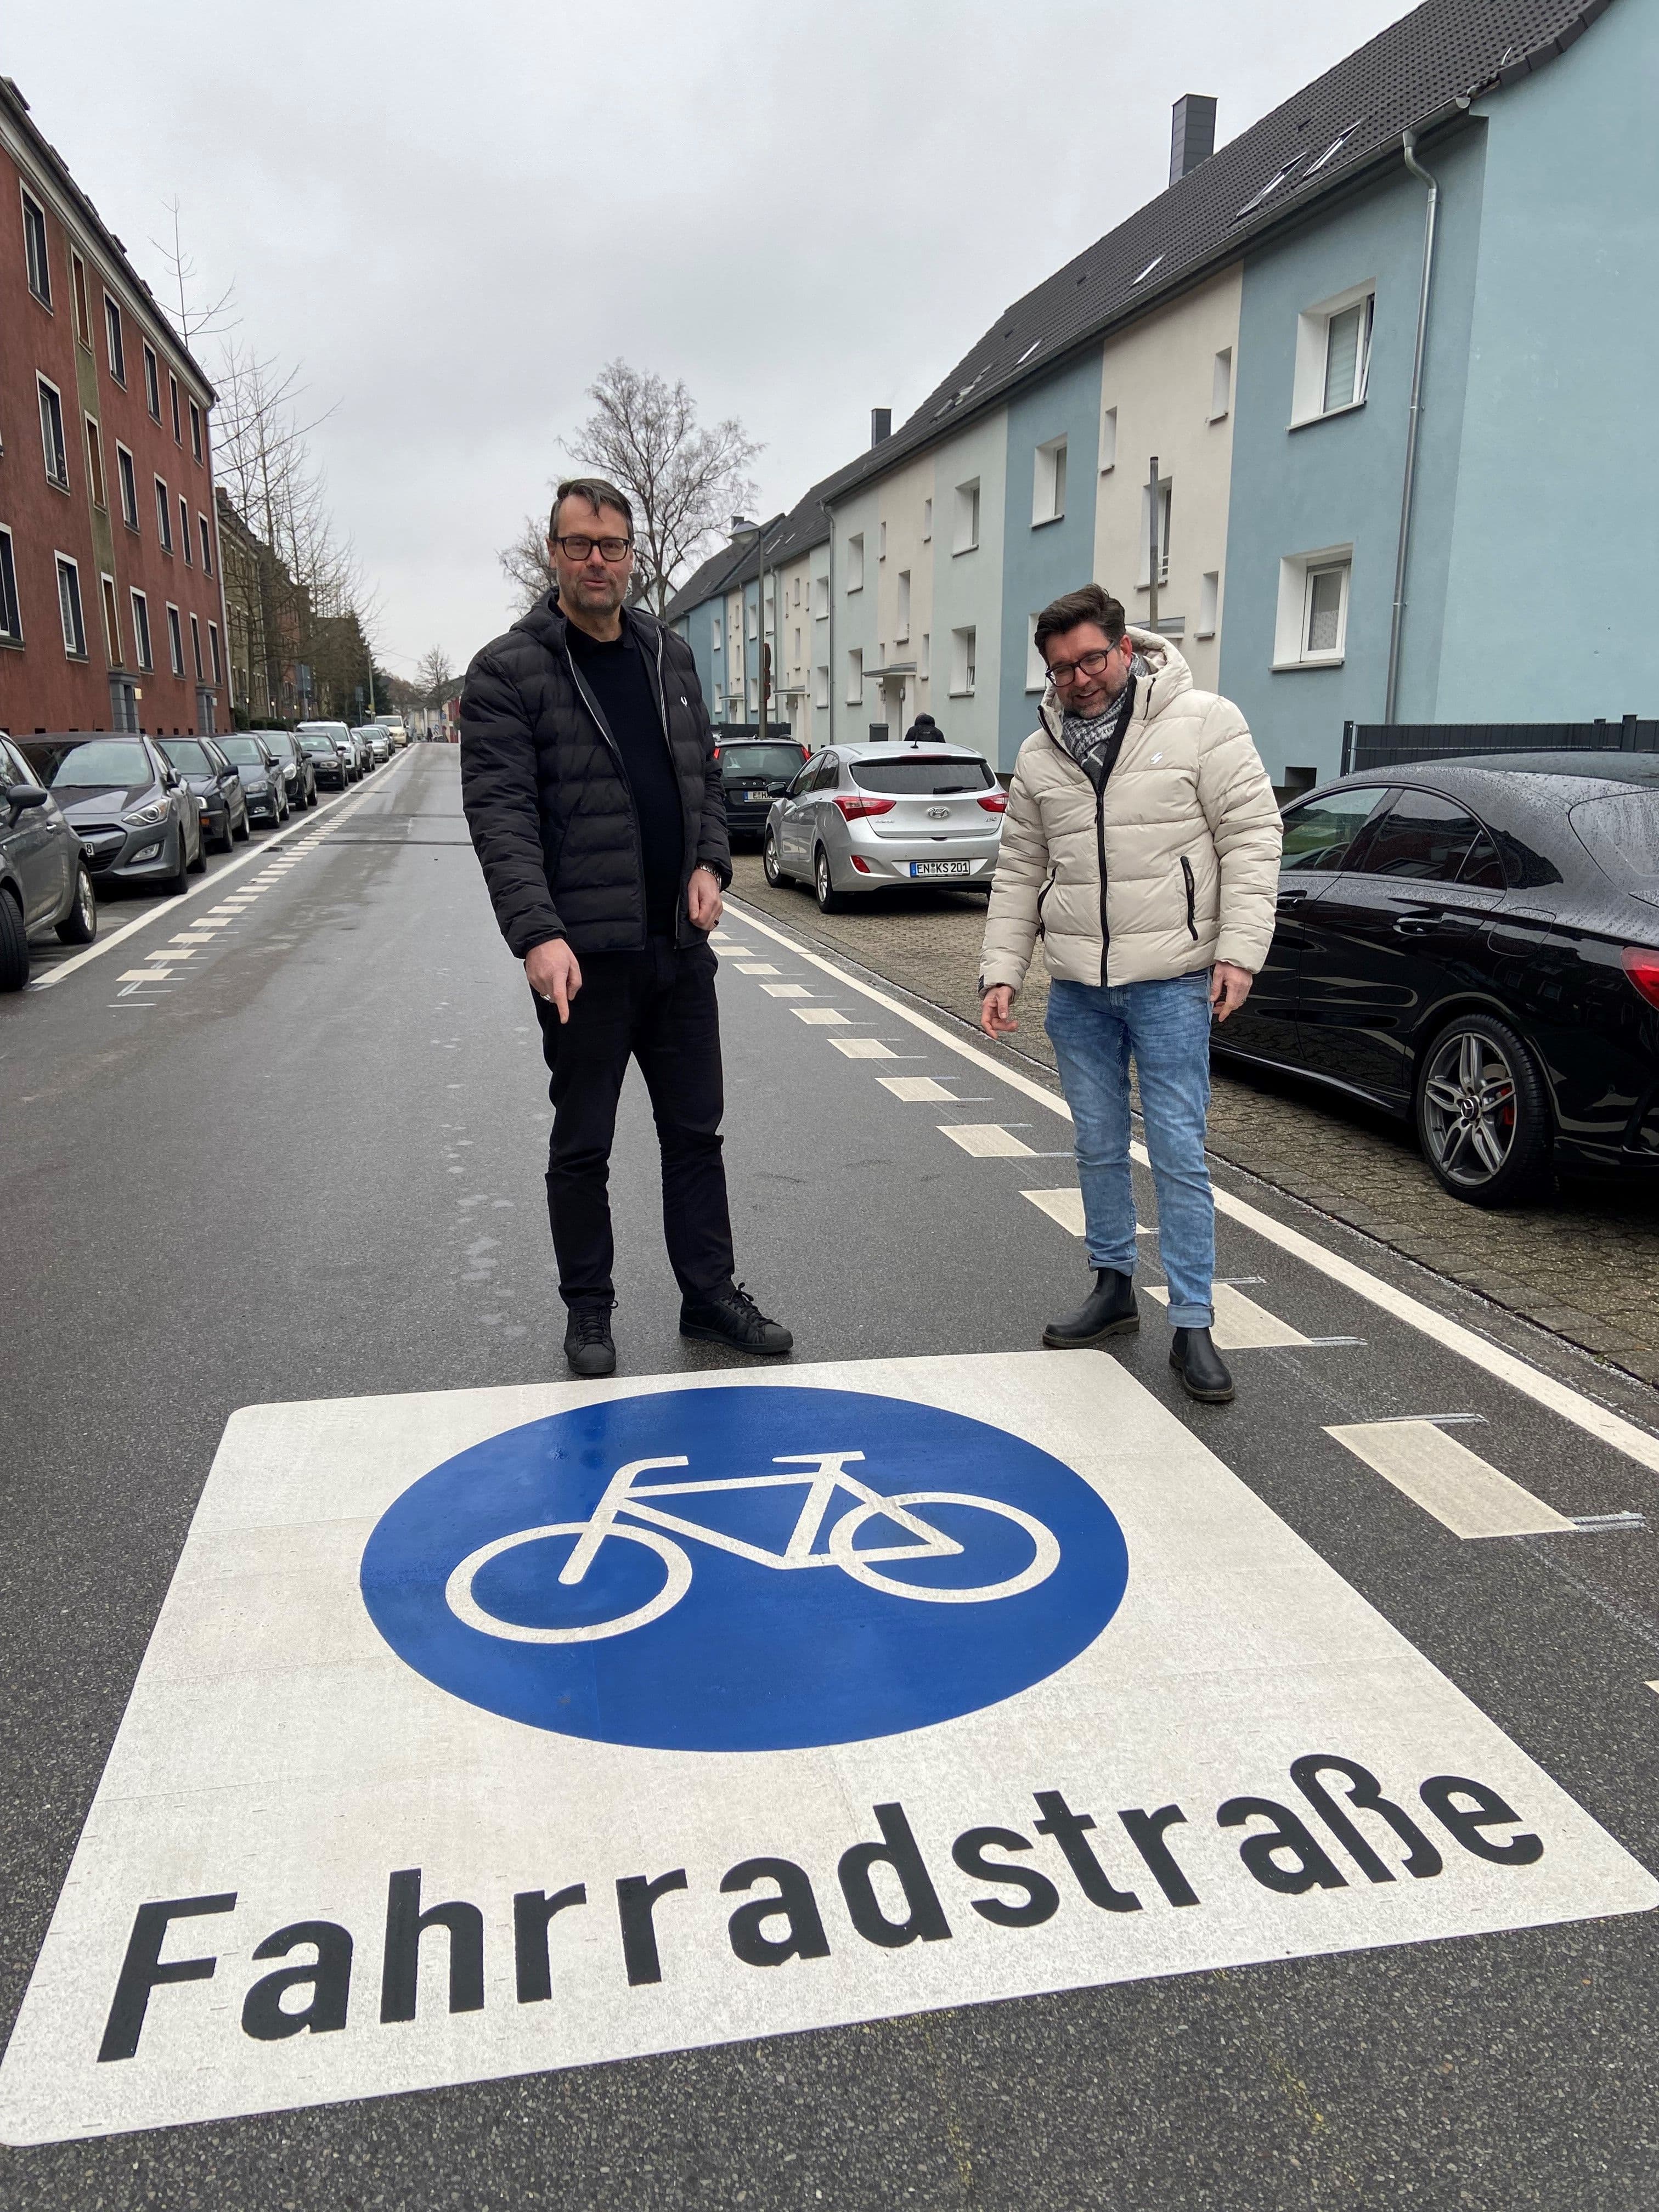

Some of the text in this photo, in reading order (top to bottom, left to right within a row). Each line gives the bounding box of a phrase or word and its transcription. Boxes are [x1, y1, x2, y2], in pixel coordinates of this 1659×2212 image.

[917, 864, 930, 873] EN
[936, 863, 949, 873] KS
[951, 862, 968, 872] 201
[98, 1754, 1544, 2063] Fahrradstraße
